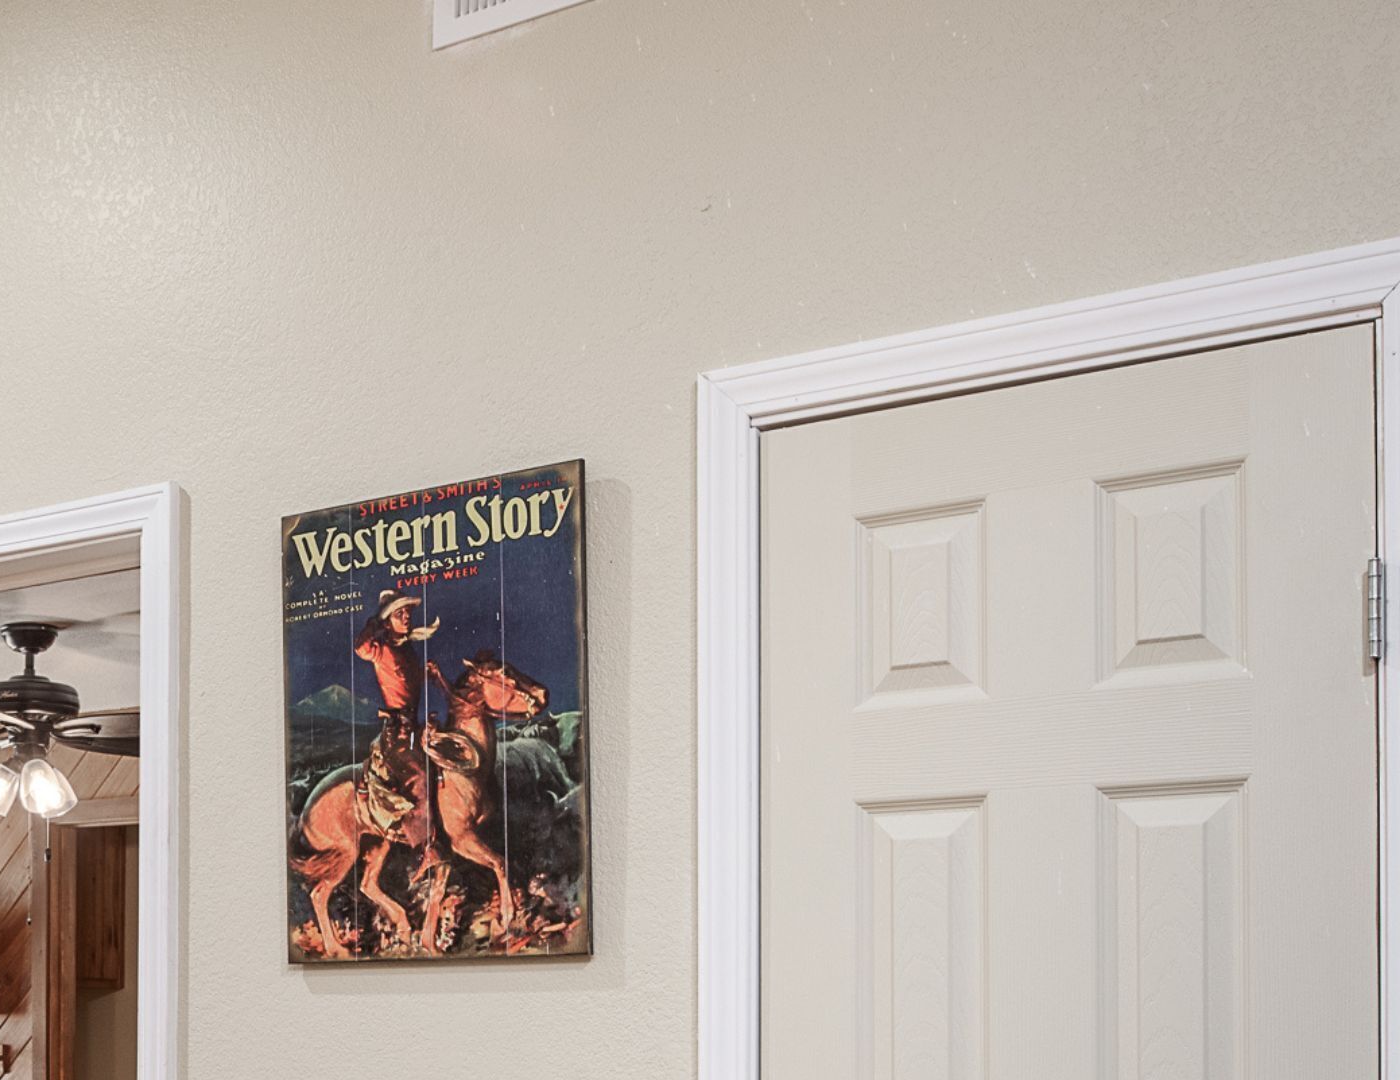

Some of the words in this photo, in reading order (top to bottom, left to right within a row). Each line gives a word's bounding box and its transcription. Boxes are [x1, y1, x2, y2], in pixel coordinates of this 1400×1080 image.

[359, 492, 418, 517] STREET
[423, 490, 433, 504] &
[437, 478, 502, 500] SMITHS
[292, 509, 458, 578] Western
[465, 486, 574, 547] Story
[390, 551, 485, 576] Magazine
[397, 573, 437, 589] EVERY
[443, 566, 478, 580] WEEK
[285, 597, 328, 610] COMPLETE
[334, 591, 362, 601] NOVEL
[344, 604, 364, 613] CASE
